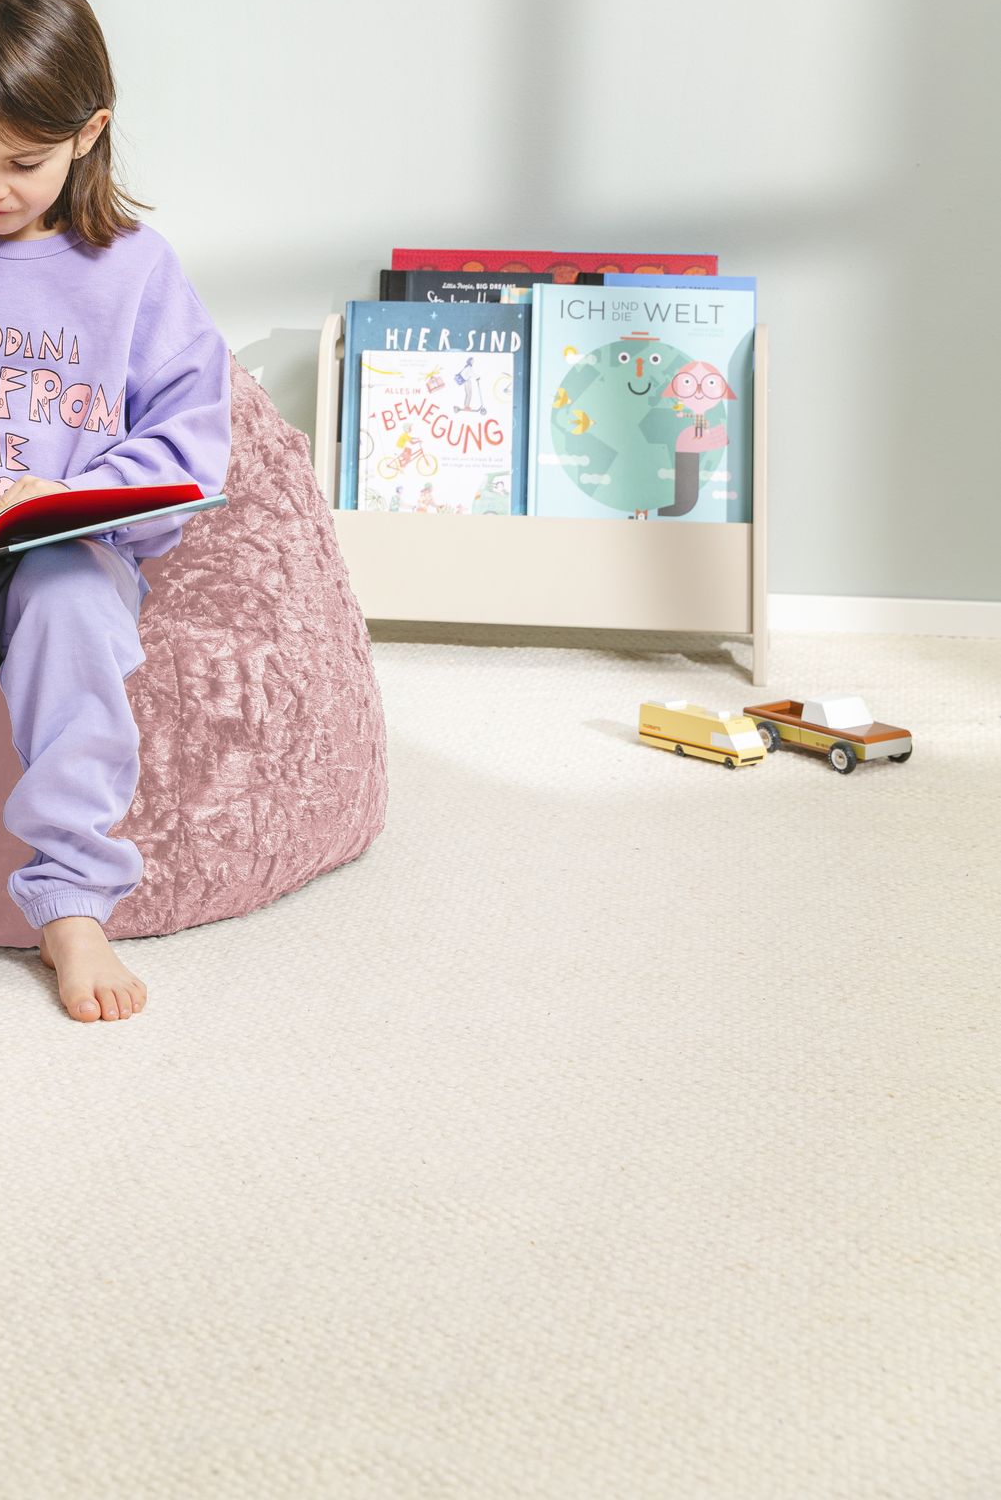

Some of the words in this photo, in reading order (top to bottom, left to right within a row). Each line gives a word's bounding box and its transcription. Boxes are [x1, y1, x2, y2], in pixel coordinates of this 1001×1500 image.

[560, 299, 606, 321] ICH
[612, 301, 639, 311] UND
[612, 312, 632, 322] DIE
[644, 302, 725, 325] WELT
[385, 327, 451, 351] HIER
[465, 330, 522, 353] SIND
[384, 387, 411, 395] ALLES
[412, 387, 421, 395] IN
[381, 398, 504, 454] BEWEGUNG
